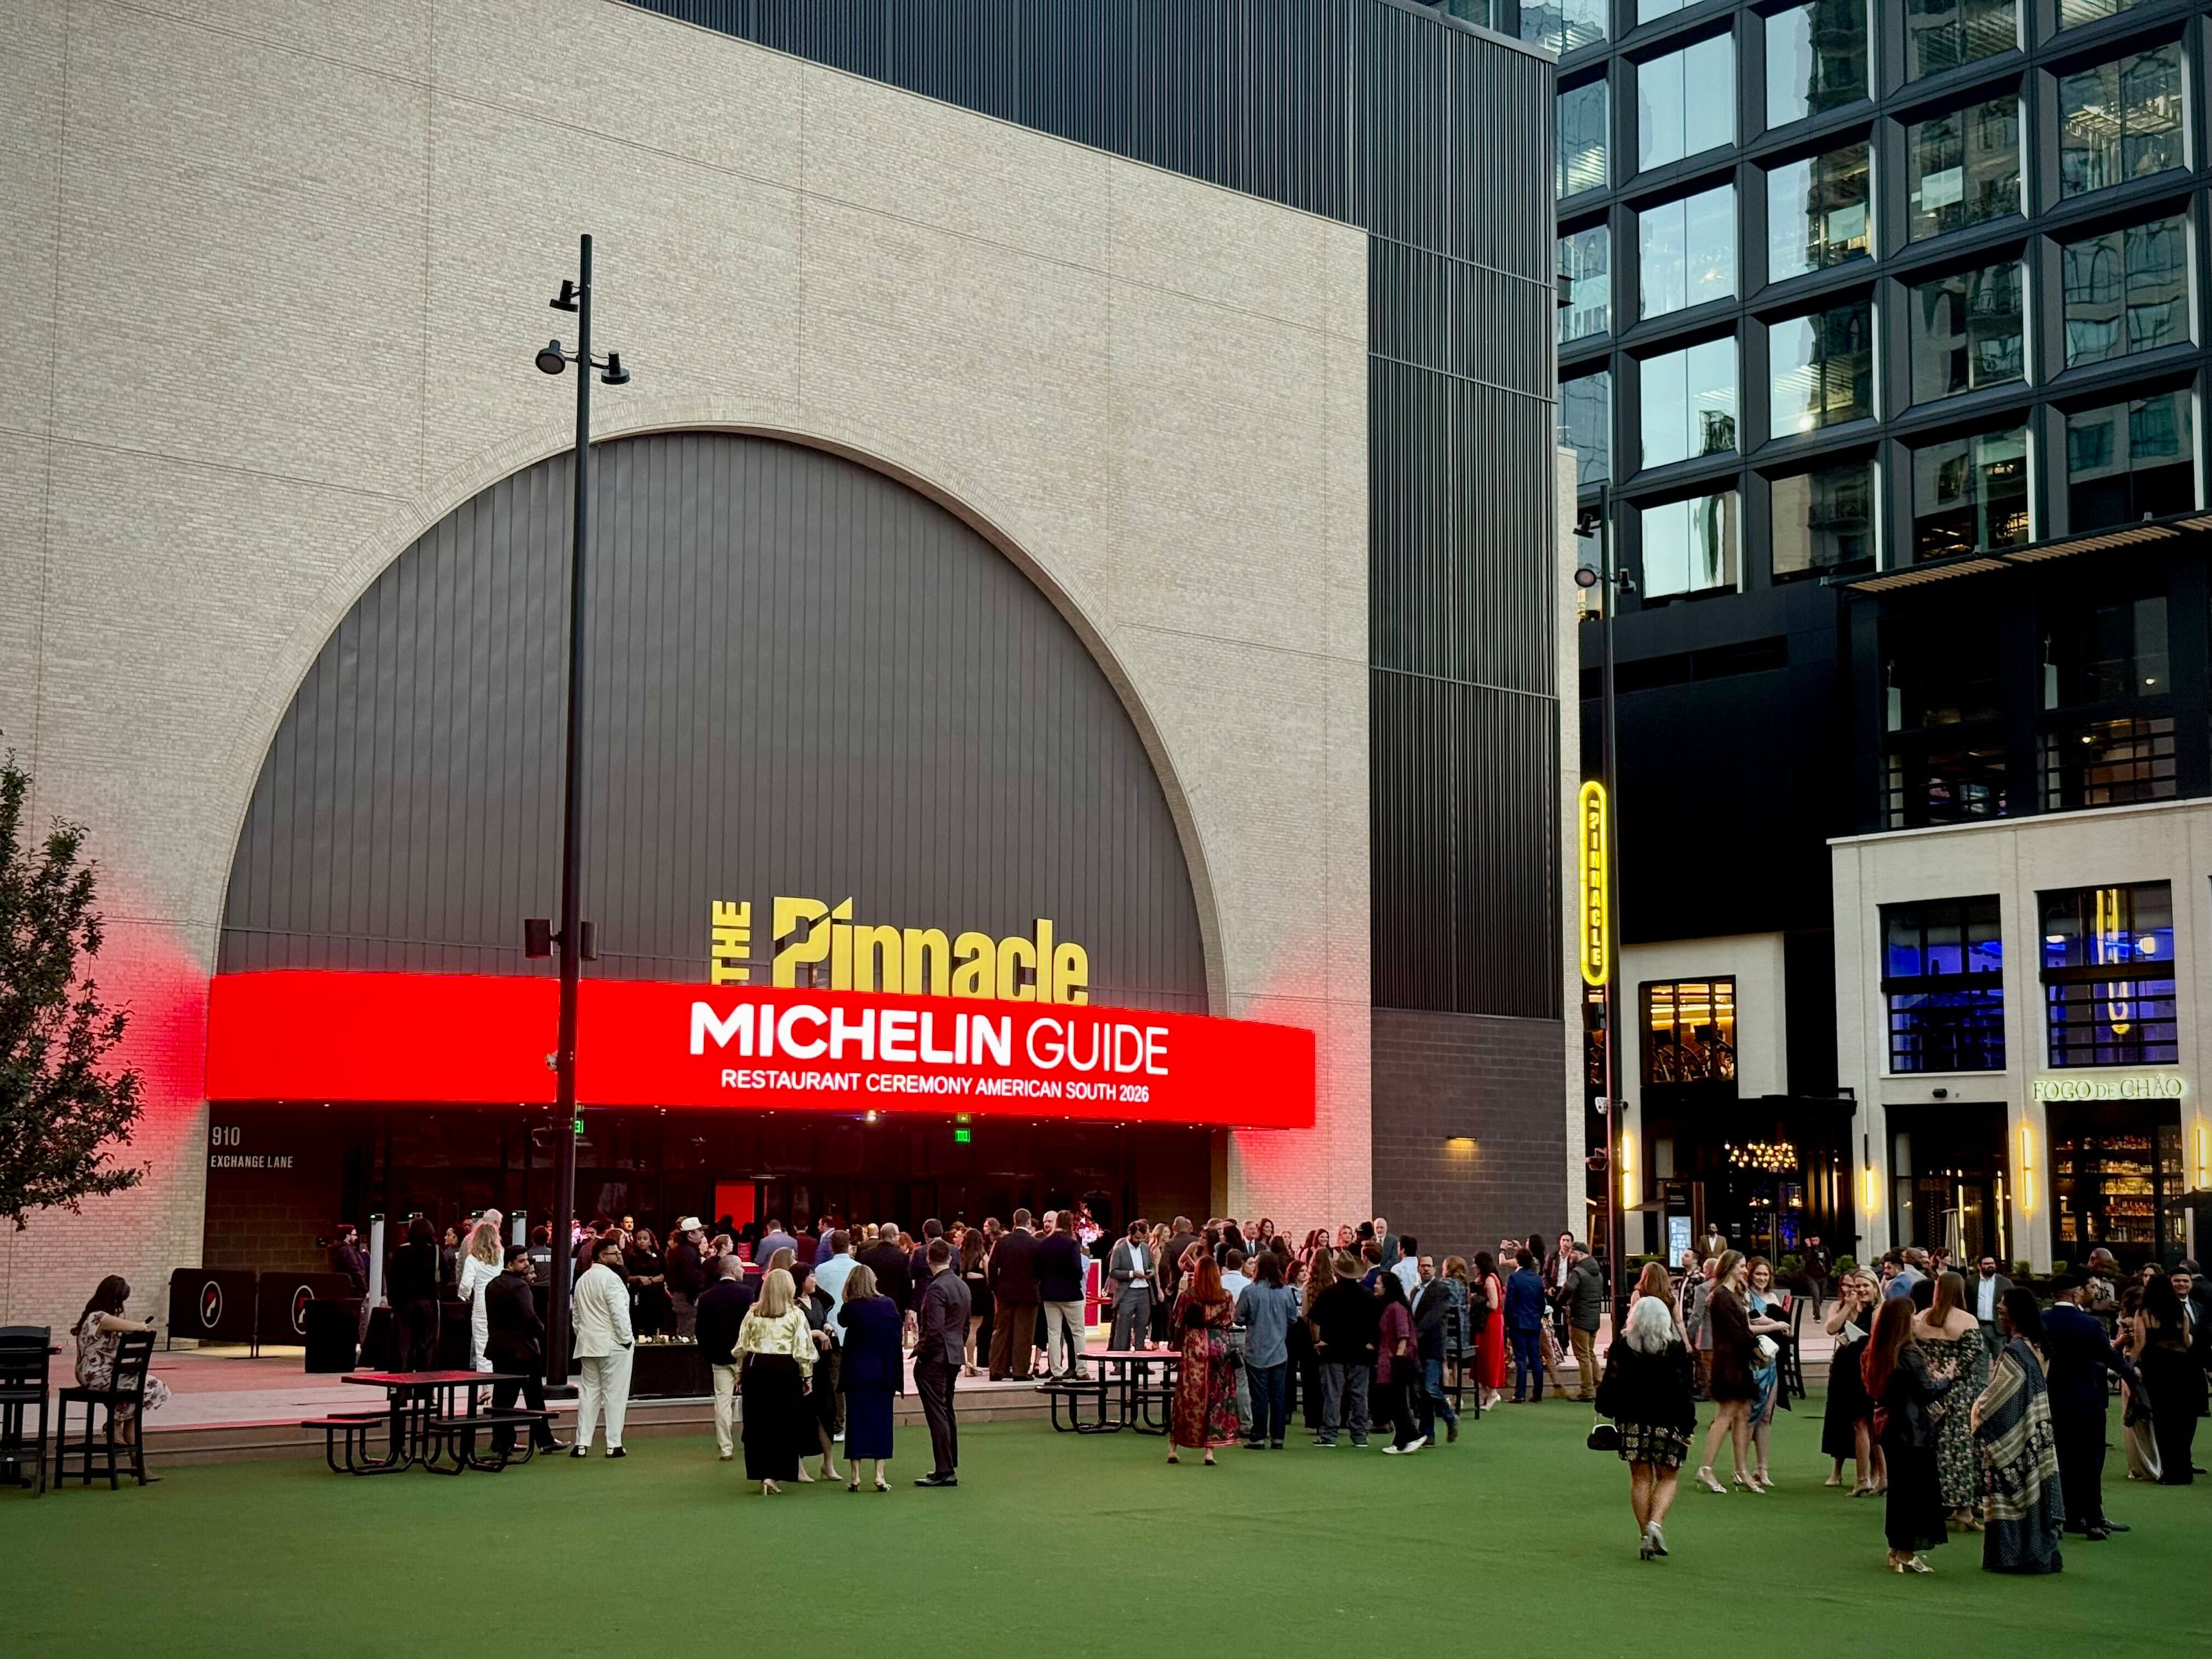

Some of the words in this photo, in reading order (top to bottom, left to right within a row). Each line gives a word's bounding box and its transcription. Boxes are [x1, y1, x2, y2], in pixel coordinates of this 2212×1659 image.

[1588, 812, 1601, 966] PINNACLE
[711, 900, 751, 986] THE
[772, 896, 1089, 1006] Pinnacle
[690, 1001, 1012, 1067] MICHELIN
[1026, 1017, 1169, 1075] GUIDE
[721, 1069, 862, 1090] RESTAURANT
[866, 1073, 973, 1094] CEREMONY
[975, 1077, 1062, 1098] AMERICAN
[1066, 1081, 1116, 1101] SOUTH
[1119, 1084, 1150, 1103] 2026
[2033, 1080, 2091, 1101] FOGO
[2120, 1073, 2182, 1098] CHÃO
[212, 1126, 241, 1146] 910
[211, 1155, 265, 1168] EXCHANGE
[267, 1156, 293, 1168] LANE
